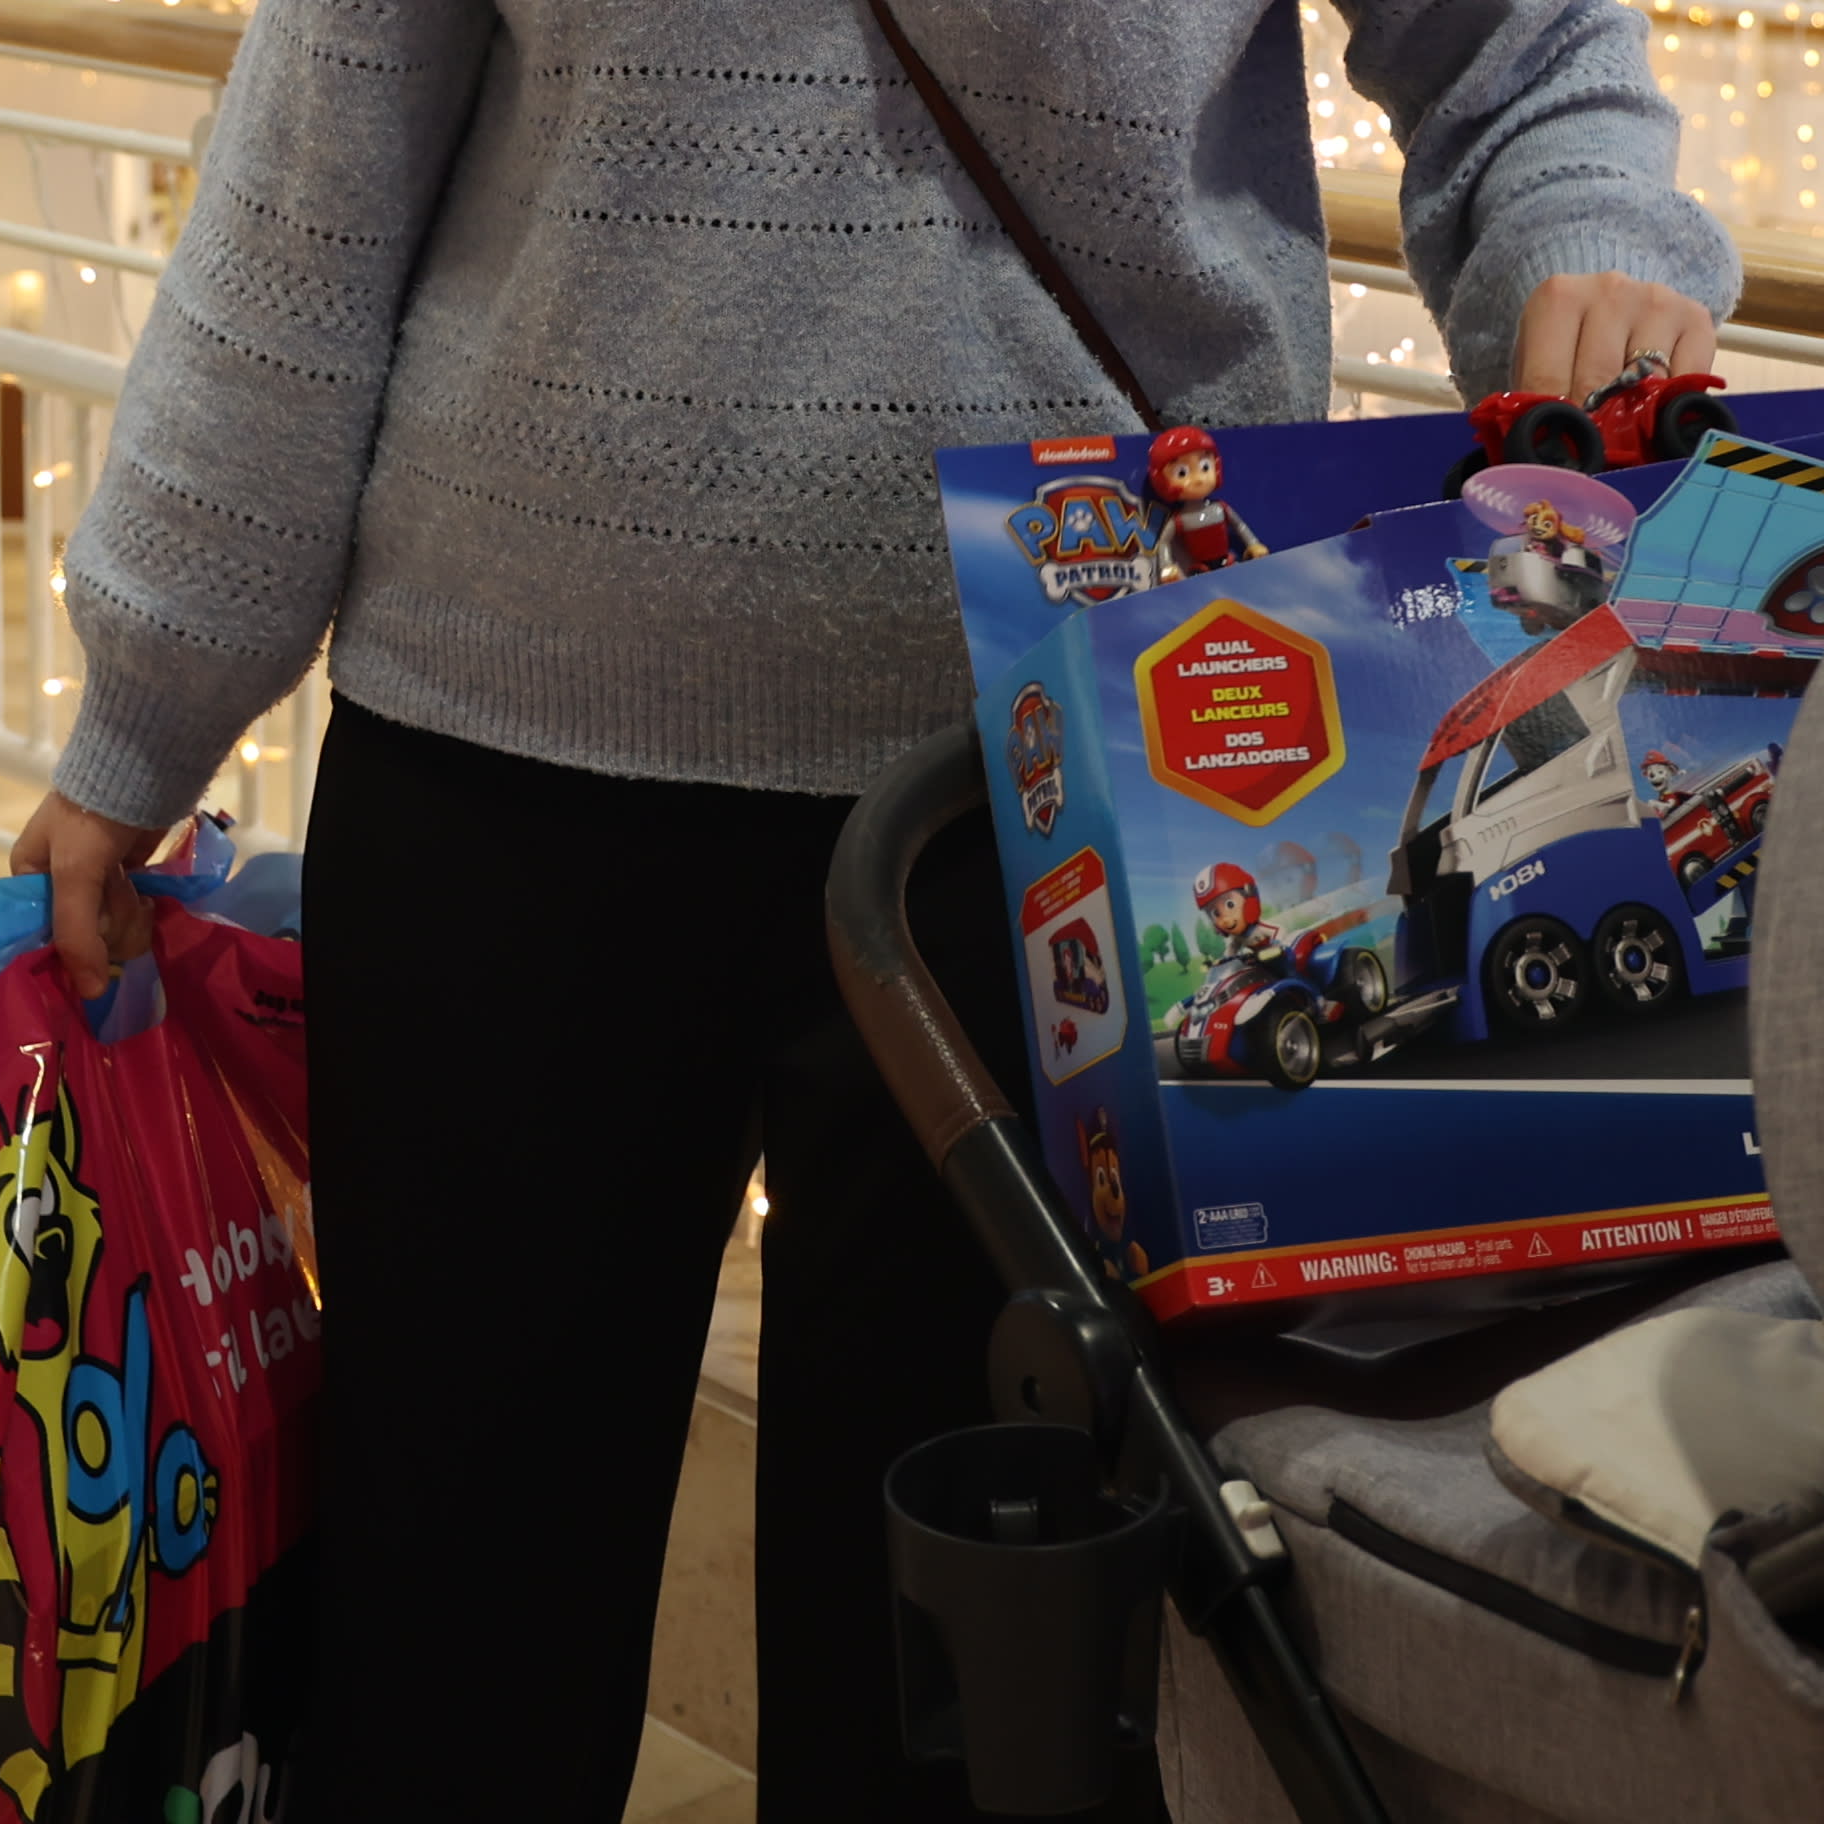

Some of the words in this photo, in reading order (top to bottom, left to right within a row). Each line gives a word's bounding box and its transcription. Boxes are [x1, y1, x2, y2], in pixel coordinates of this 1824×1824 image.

[1004, 495, 1174, 565] PAW
[1054, 564, 1141, 586] PATROL
[1204, 640, 1255, 656] DUAL
[1177, 656, 1289, 677] LAUNCHERS
[1212, 685, 1263, 702] DEUX
[1191, 702, 1290, 723] LANCEURS
[1006, 699, 1064, 794] PAW
[1225, 731, 1264, 747] DOS
[1185, 746, 1311, 770] LANZADORES
[1581, 1220, 1682, 1251] ATTENTION
[1436, 1241, 1467, 1257] HAZARD
[1300, 1252, 1399, 1282] WARNING:
[1207, 1276, 1236, 1296] 3+
